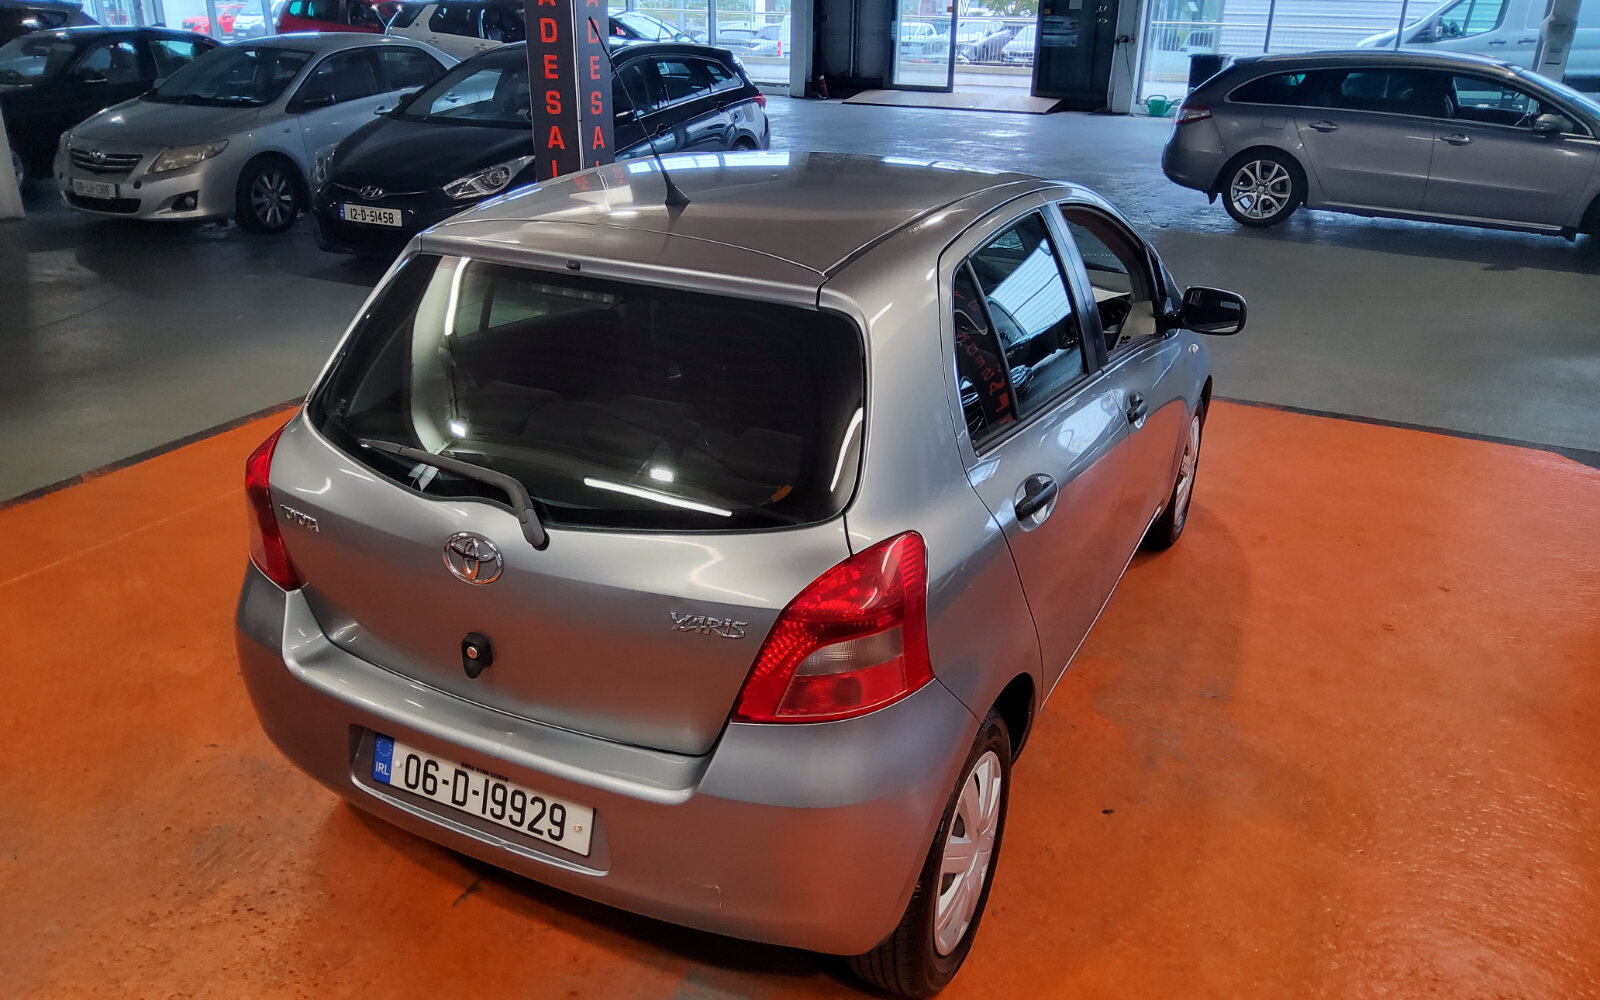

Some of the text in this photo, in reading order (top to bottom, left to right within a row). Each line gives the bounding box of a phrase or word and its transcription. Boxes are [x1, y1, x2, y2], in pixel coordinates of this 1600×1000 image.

[350, 208, 394, 224] 12-D-51458
[375, 761, 390, 776] IRL
[404, 753, 567, 842] 06-D-19929
